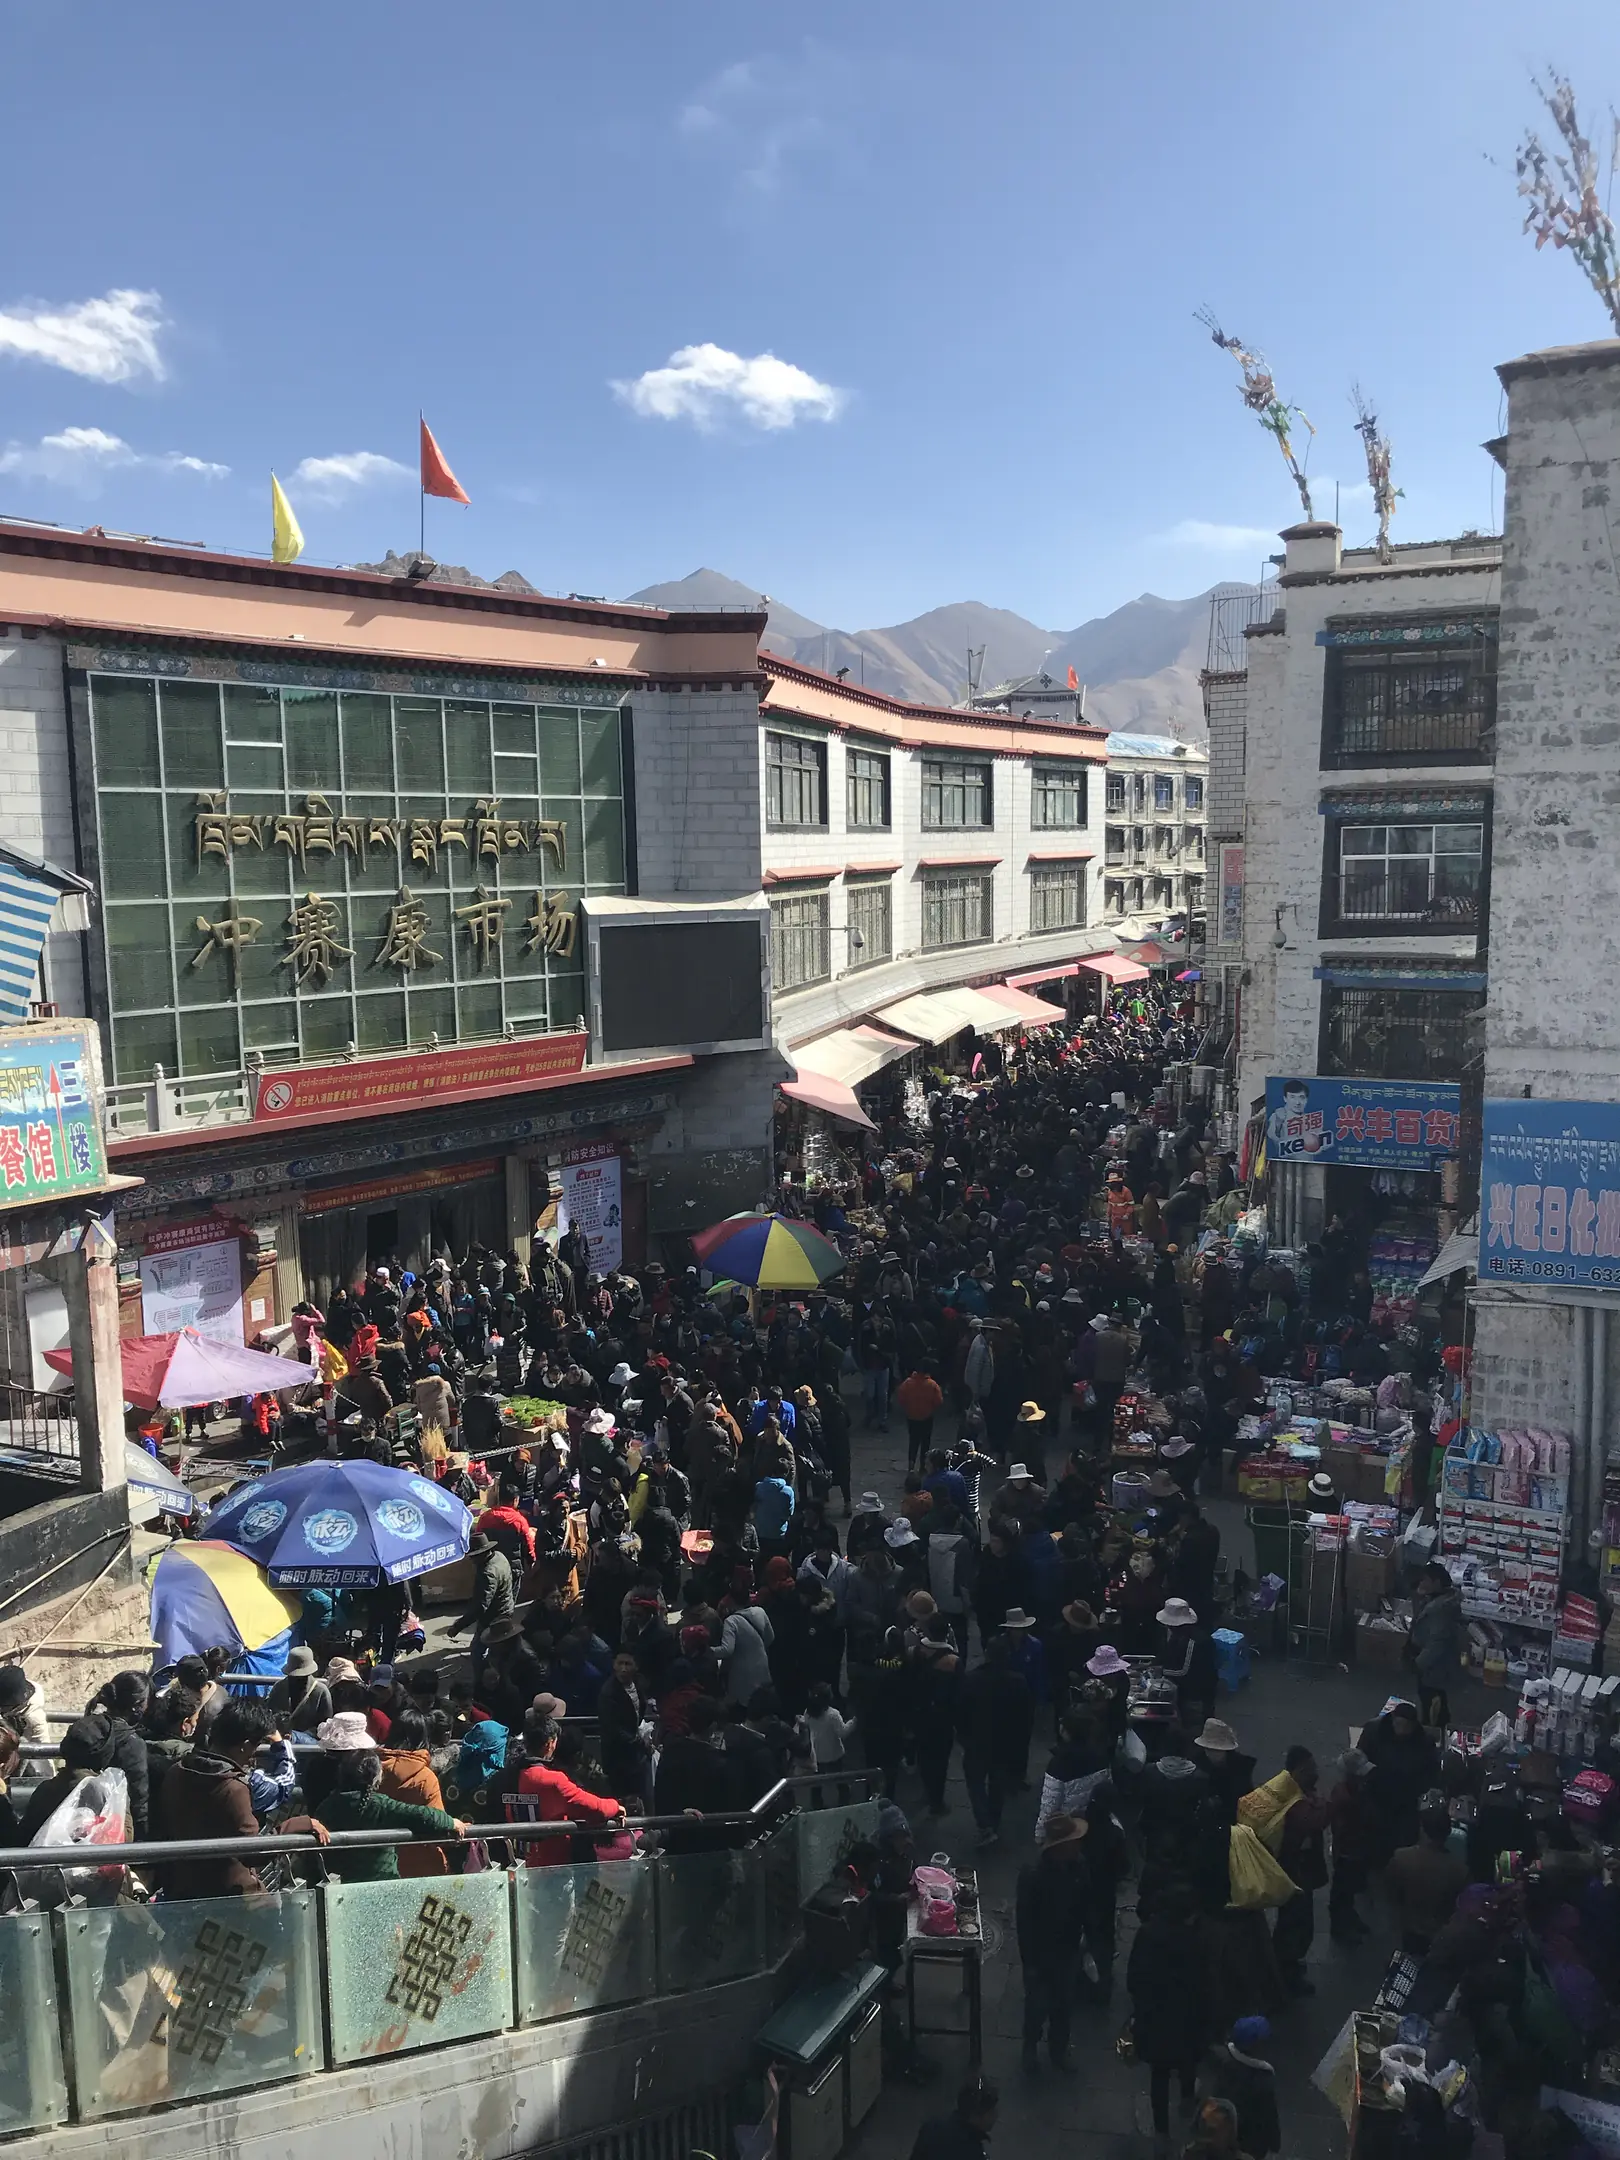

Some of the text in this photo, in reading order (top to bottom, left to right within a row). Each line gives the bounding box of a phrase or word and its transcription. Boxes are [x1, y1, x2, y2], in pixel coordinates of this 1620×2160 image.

[192, 883, 577, 989] 冲赛康市场
[1287, 1110, 1323, 1136] 奇强
[1336, 1105, 1460, 1148] 兴丰百货
[278, 1568, 369, 1586] 随时脉动回来
[391, 1544, 456, 1578] 随时脉动回来
